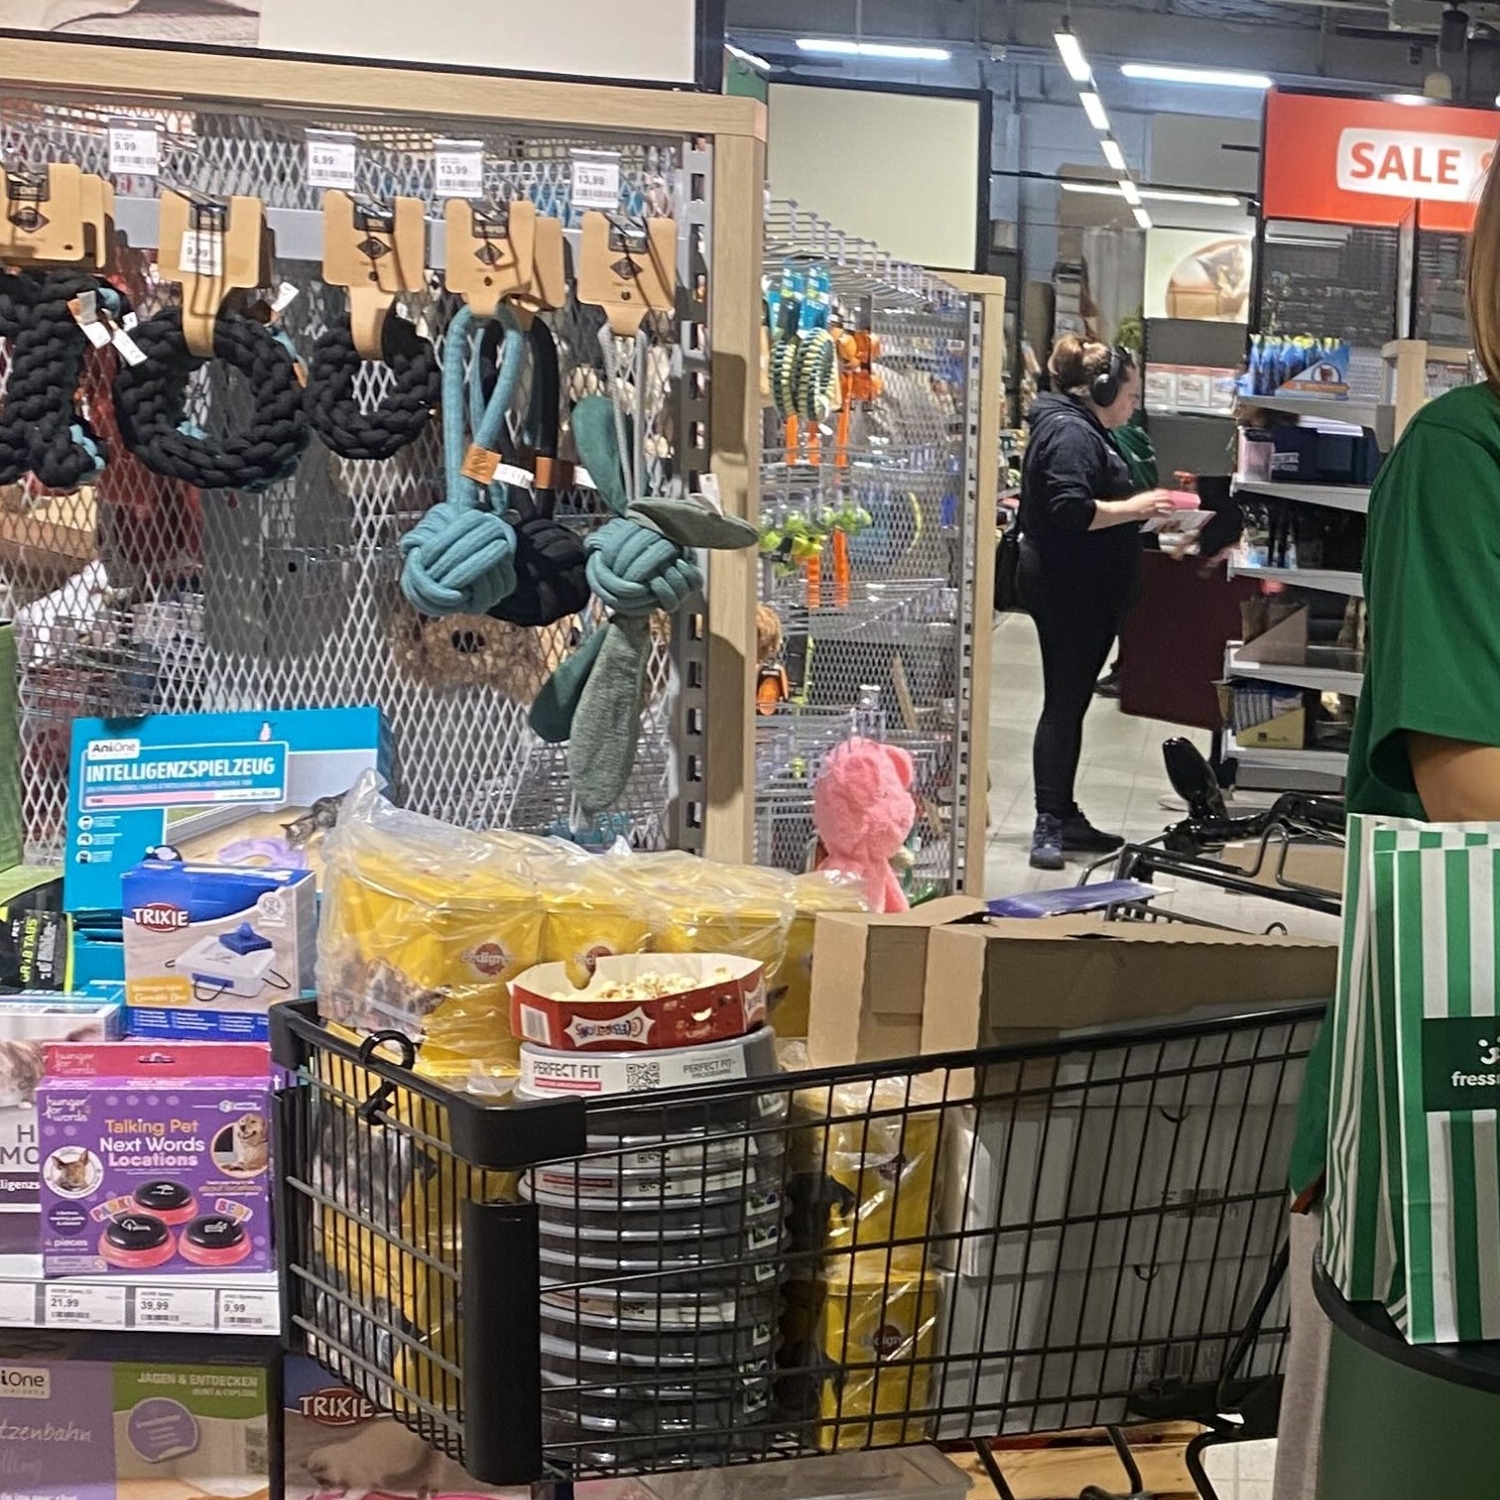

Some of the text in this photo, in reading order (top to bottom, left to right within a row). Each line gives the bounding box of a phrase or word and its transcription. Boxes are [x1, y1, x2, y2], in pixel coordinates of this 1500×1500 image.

[1350, 141, 1461, 185] SALE
[91, 741, 137, 755] AniOne
[86, 757, 275, 783] INTELLIGENZSPIELZEUG
[132, 907, 190, 928] TRIXIE
[534, 1060, 600, 1080] PERFECT FIT
[105, 1119, 198, 1136] Talking Pet
[100, 1137, 205, 1152] Next Words
[109, 1152, 198, 1167] Locations
[54, 1237, 88, 1249] pieces
[51, 1297, 79, 1308] 21,99
[141, 1301, 169, 1312] 39,99
[189, 1374, 258, 1388] ENTDECKEN
[299, 1395, 375, 1418] TRIXIE
